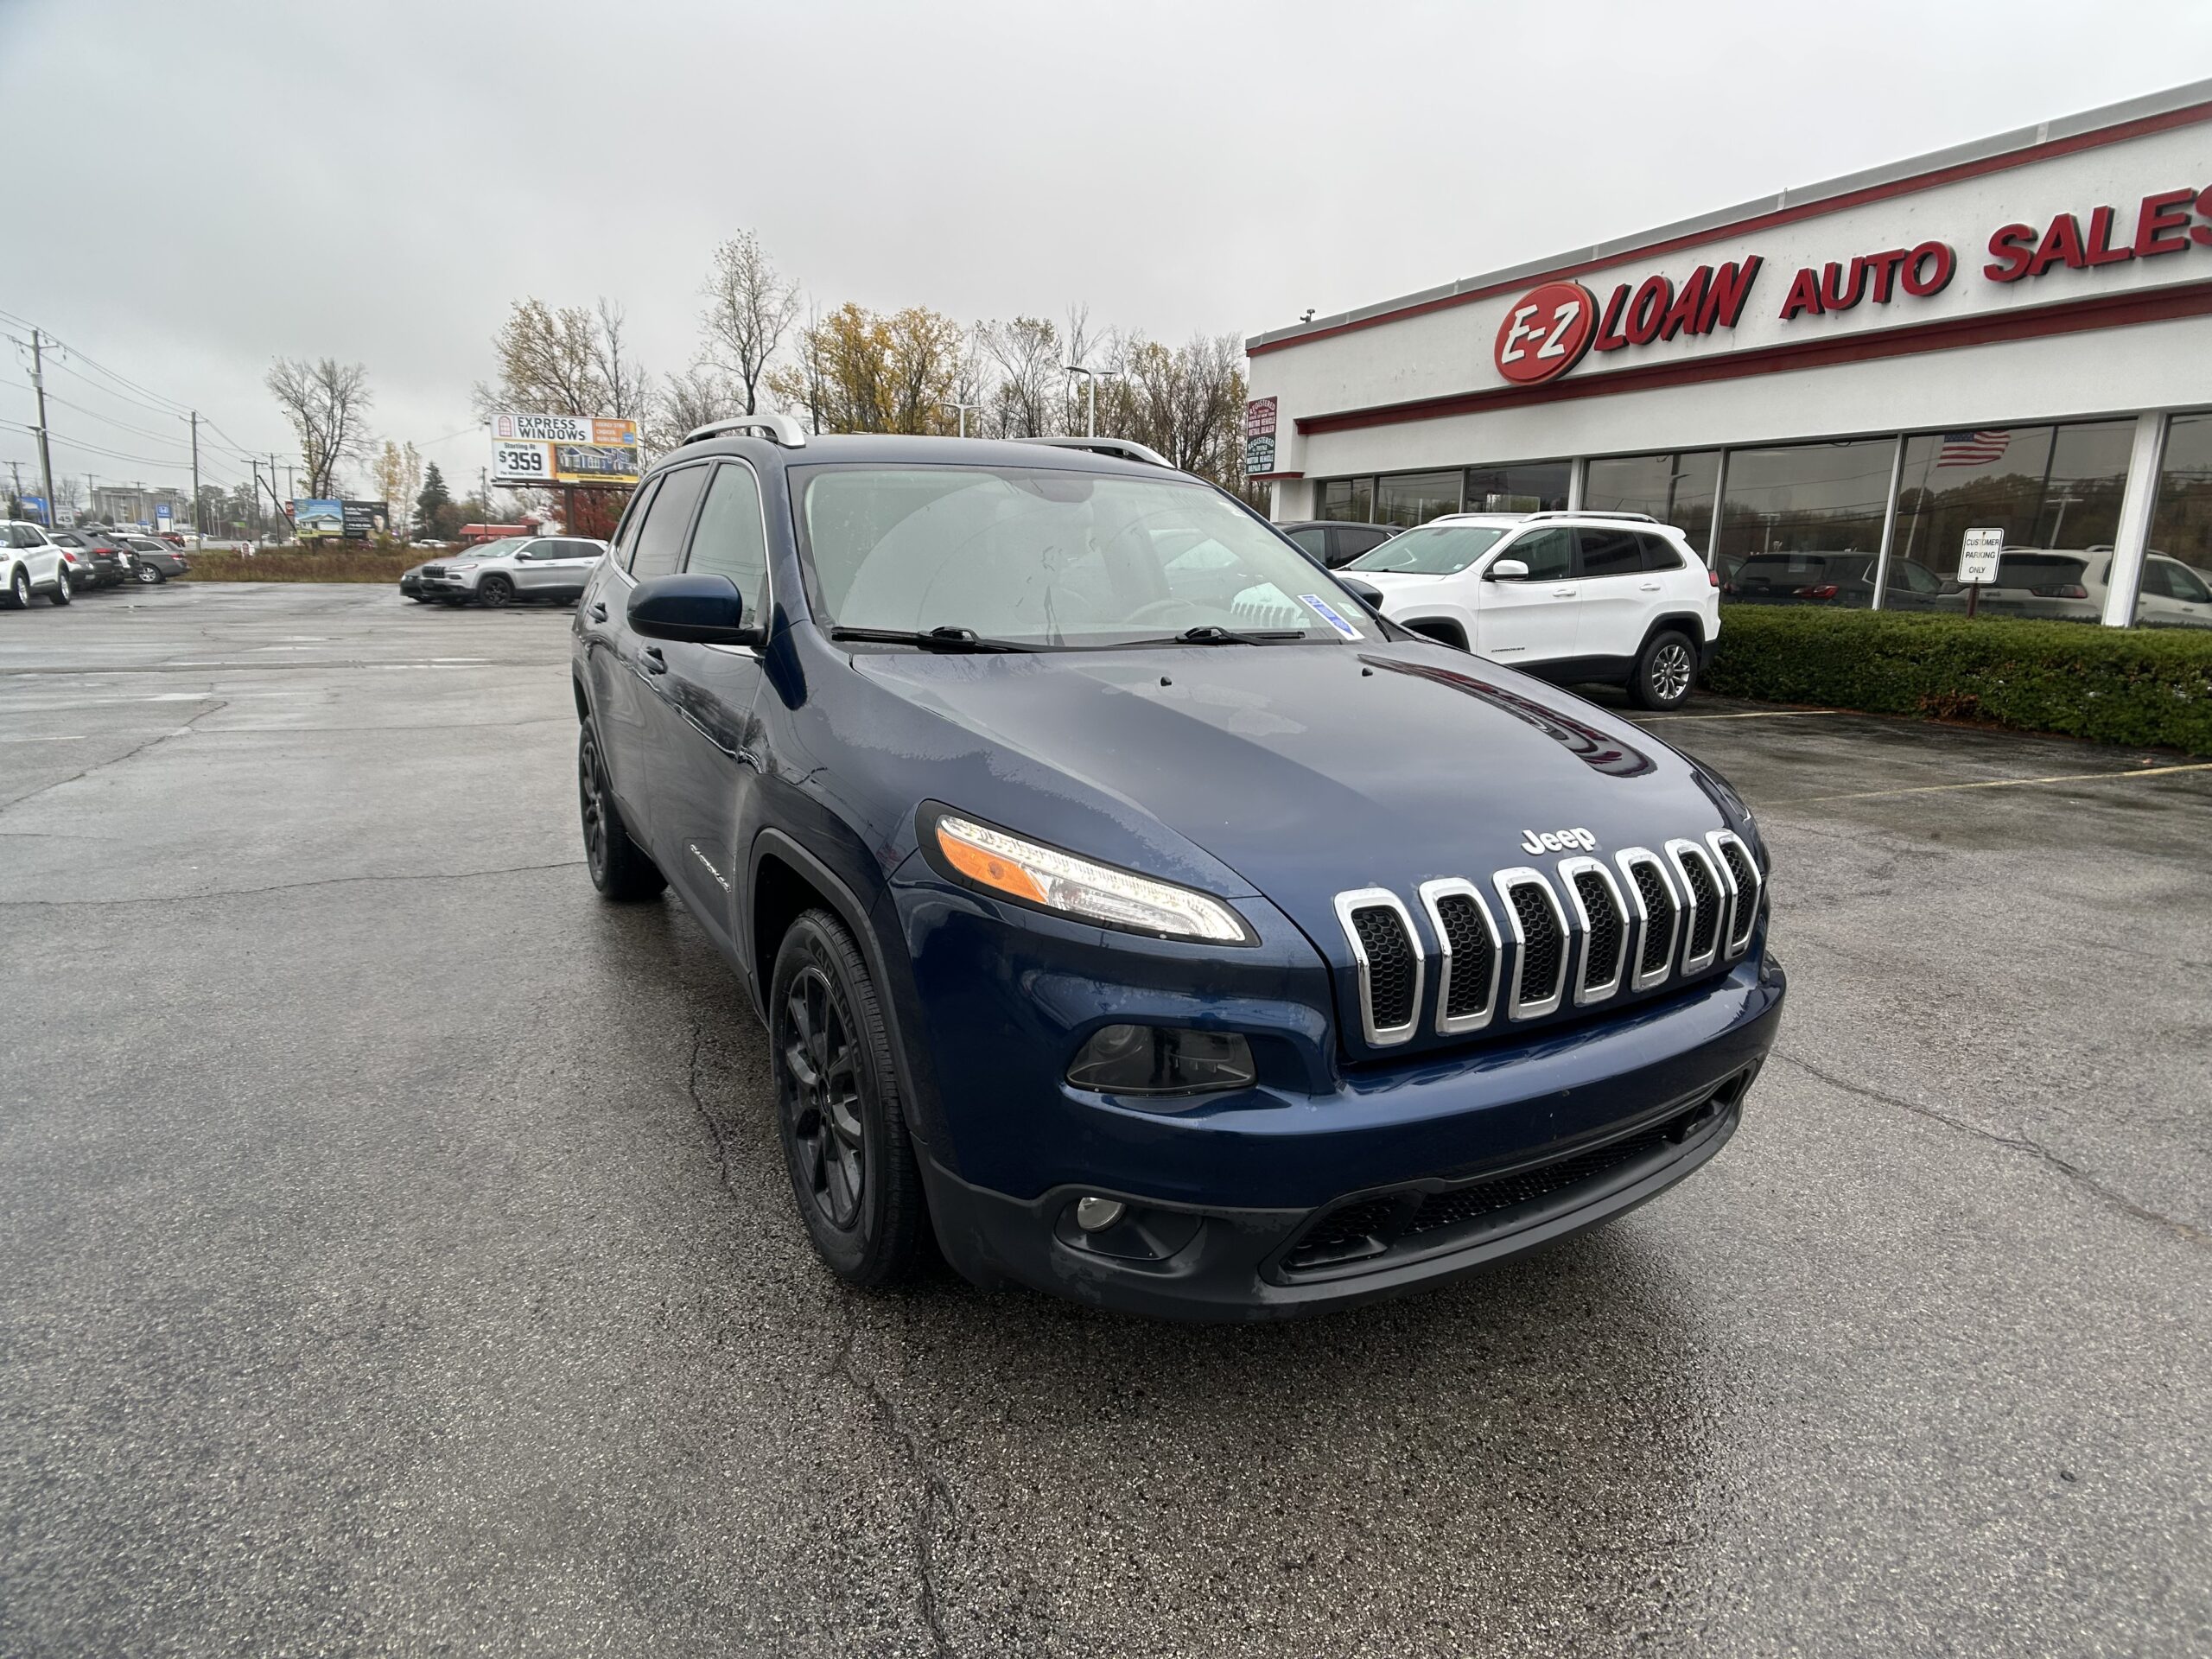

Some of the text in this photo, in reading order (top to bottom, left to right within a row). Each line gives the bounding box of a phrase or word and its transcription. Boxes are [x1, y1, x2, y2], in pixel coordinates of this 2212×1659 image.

[1501, 300, 1580, 365] E-Z
[1593, 254, 1764, 352] LOAN
[1778, 239, 1957, 320] AUTO
[1249, 399, 1275, 415] REGISTERED
[518, 416, 576, 430] EXPRESS
[518, 427, 586, 441] WINDOWS
[504, 442, 528, 450] Starting
[1248, 437, 1274, 450] REGISTERED
[499, 450, 542, 471] $359
[1521, 827, 1597, 856] Jeep
